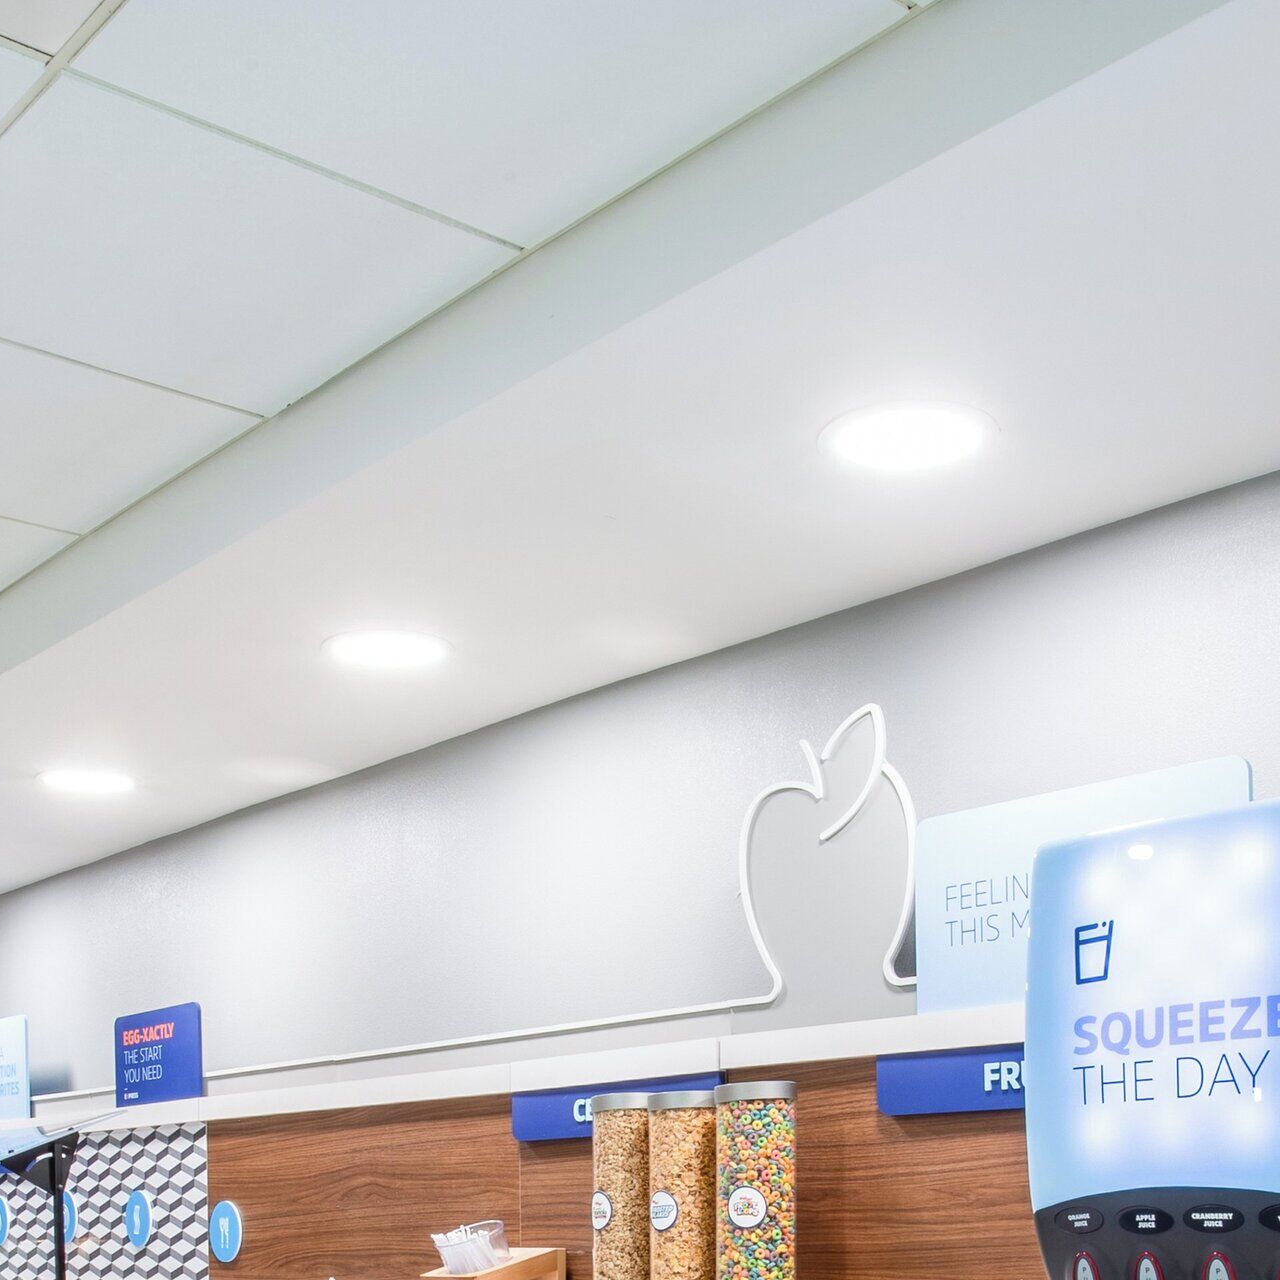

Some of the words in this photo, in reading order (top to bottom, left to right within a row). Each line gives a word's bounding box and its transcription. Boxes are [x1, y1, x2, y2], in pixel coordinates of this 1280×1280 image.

[945, 914, 1000, 947] THIS
[122, 1022, 175, 1046] EGG-XACTLY
[123, 1048, 138, 1065] THE
[139, 1045, 163, 1063] START
[124, 1067, 141, 1083] YOU
[142, 1064, 163, 1081] NEED
[984, 1061, 1024, 1091] FR
[1073, 1060, 1154, 1105] THE
[1176, 1050, 1270, 1098] DAY
[1068, 1213, 1090, 1221] ORANGE
[1074, 1220, 1088, 1228] JUICE
[1138, 1221, 1156, 1229] JUICE
[1191, 1213, 1233, 1221] CRANBERRY
[1203, 1220, 1223, 1228] JUICE
